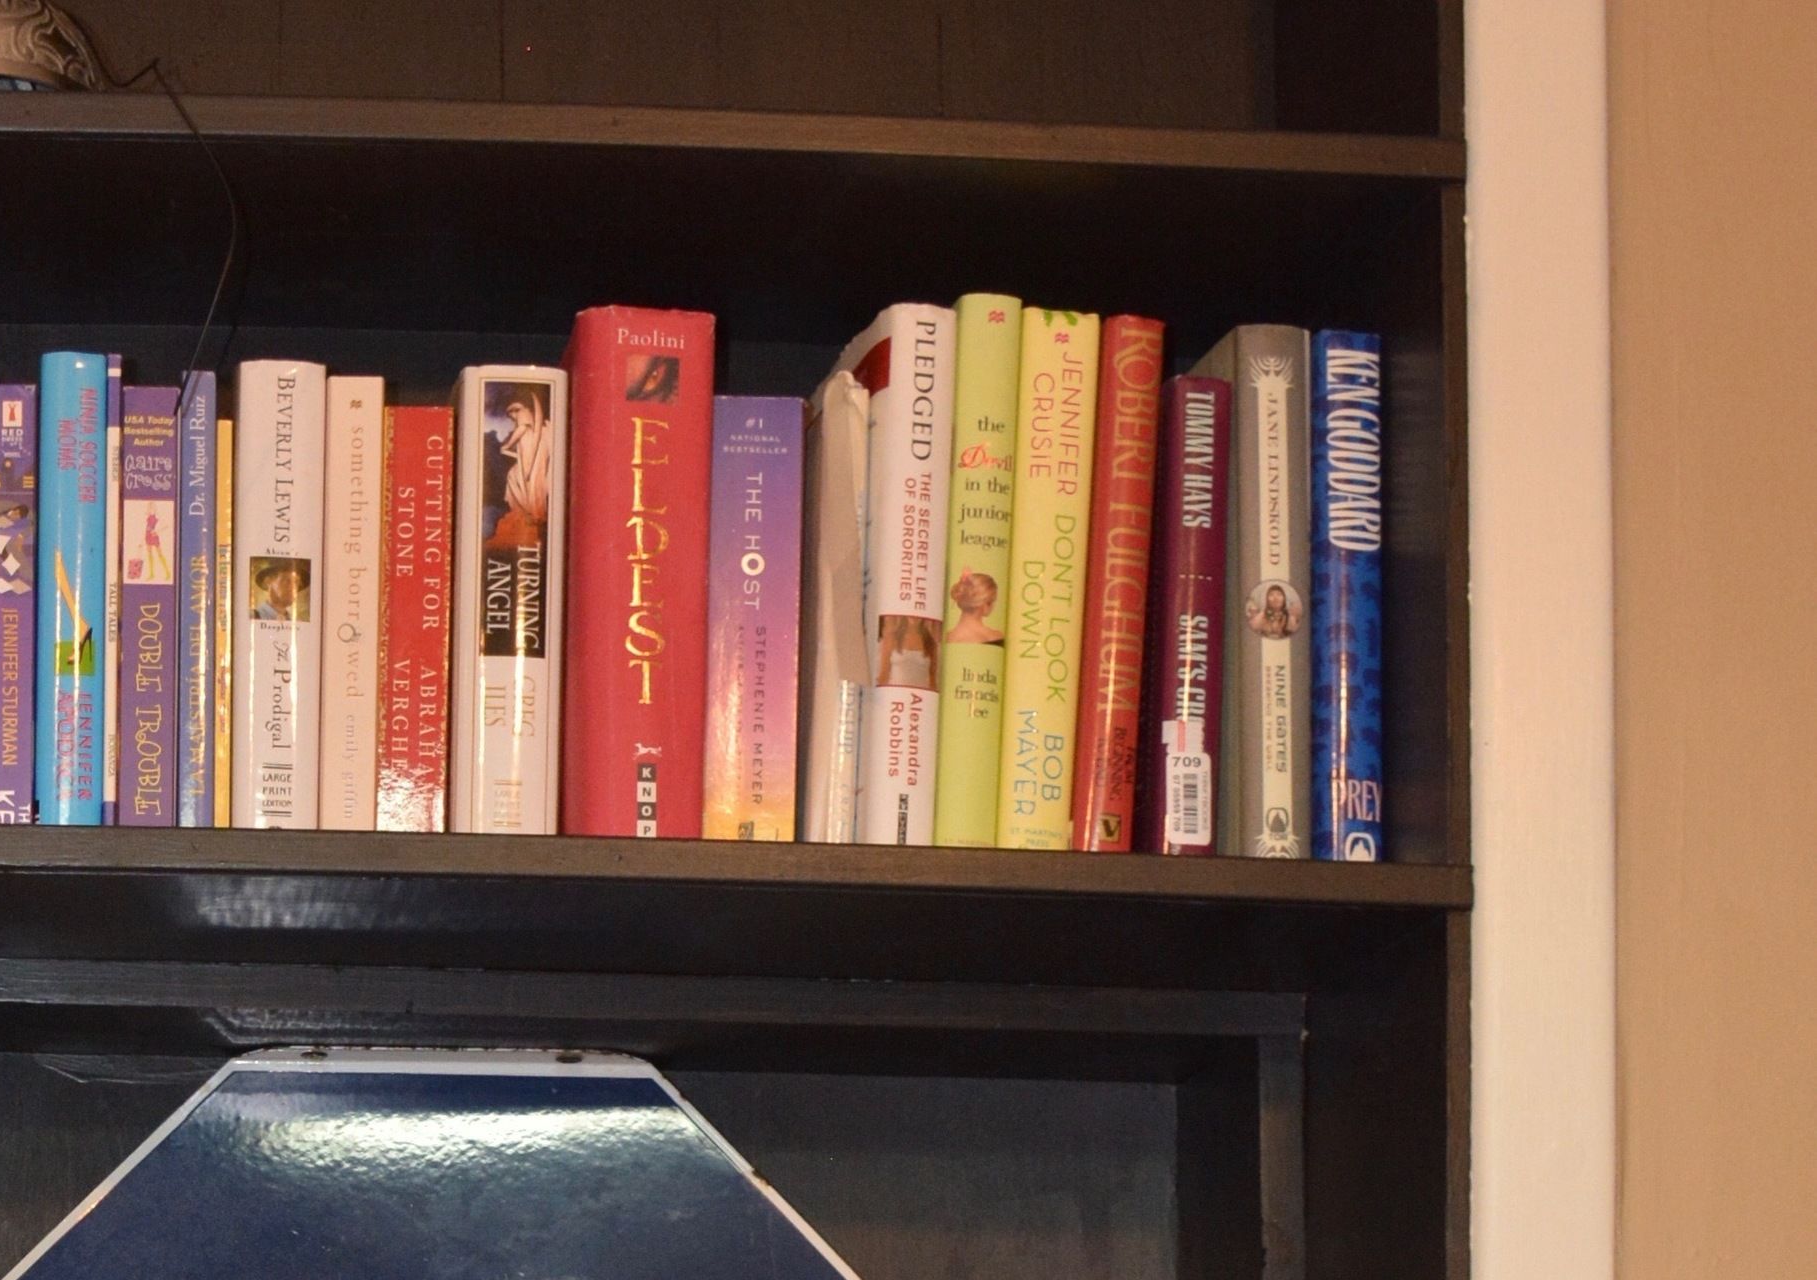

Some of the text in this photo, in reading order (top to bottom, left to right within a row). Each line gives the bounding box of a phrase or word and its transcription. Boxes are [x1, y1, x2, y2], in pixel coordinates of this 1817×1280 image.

[616, 327, 685, 350] Paolini
[910, 321, 936, 462] PLEDGED
[1326, 349, 1381, 551] KEN GODDARD
[740, 472, 766, 610] THE HOST
[136, 604, 161, 815] DOUBLE TROUBLE
[1172, 756, 1202, 768] 709
